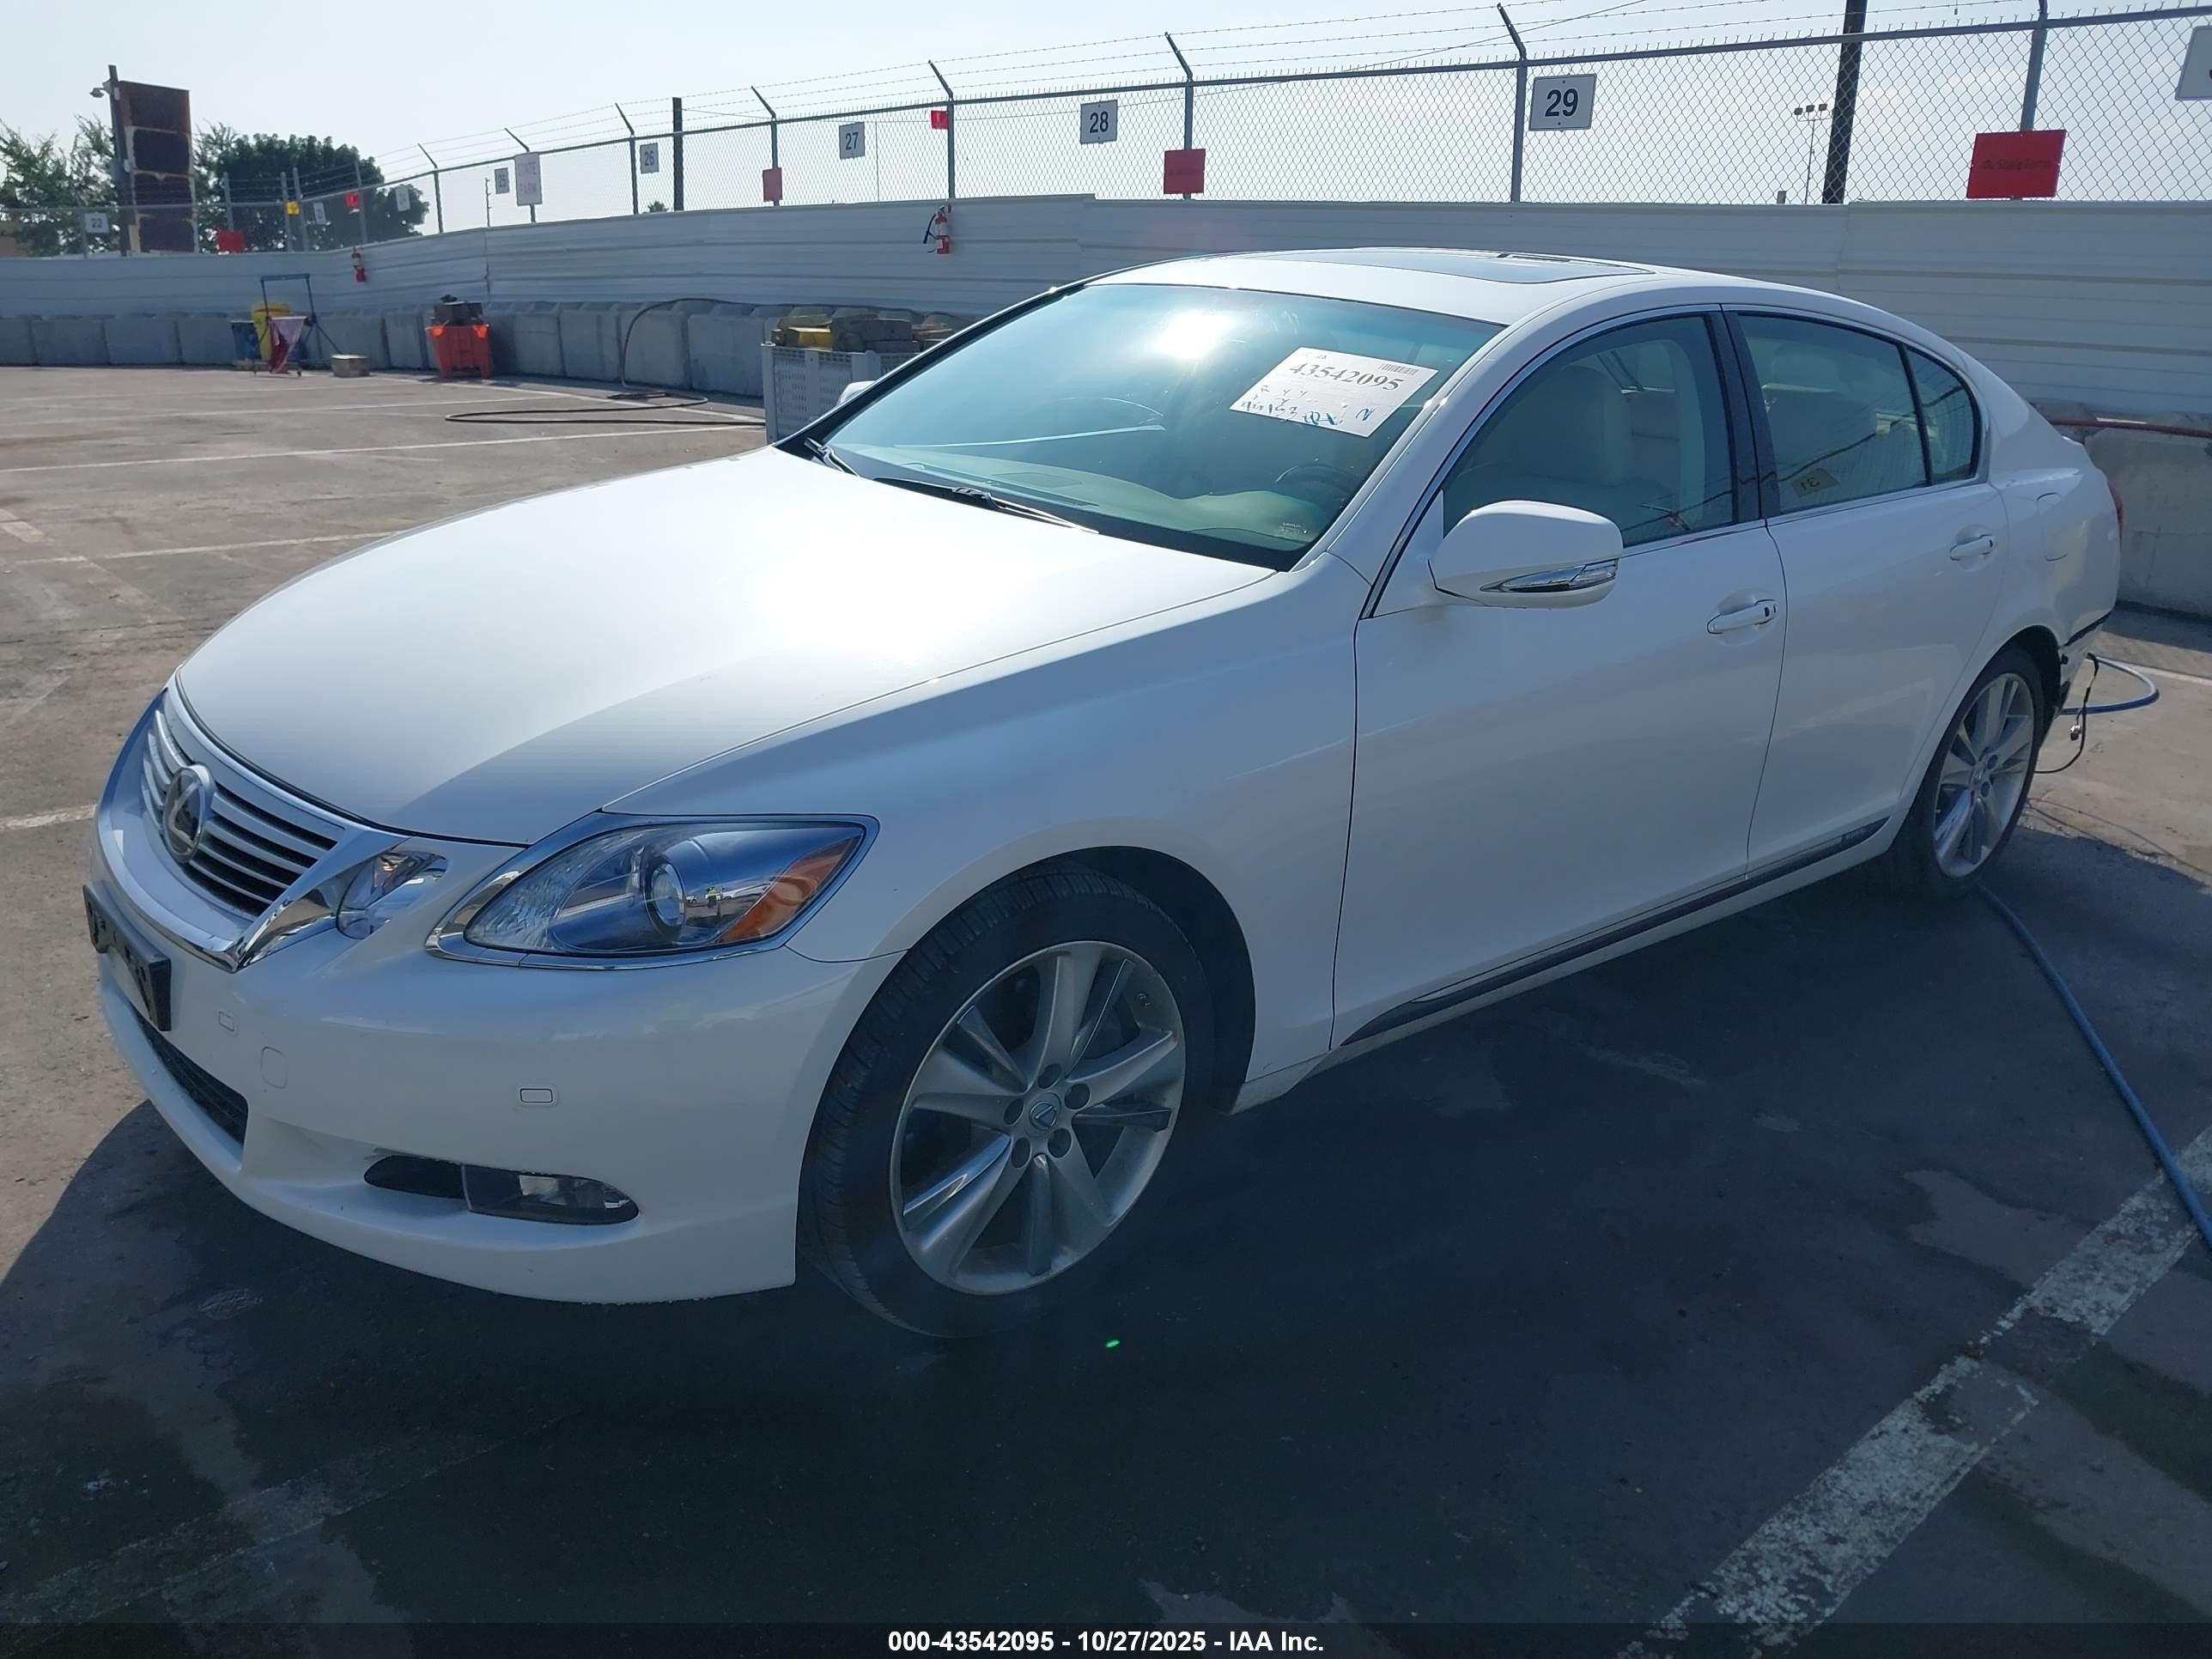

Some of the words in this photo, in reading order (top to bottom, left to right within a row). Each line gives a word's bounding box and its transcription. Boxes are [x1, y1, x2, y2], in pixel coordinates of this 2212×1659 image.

[1545, 88, 1579, 117] 29
[1089, 111, 1109, 133] 28
[845, 131, 859, 150] 27
[644, 150, 655, 167] 26
[91, 218, 103, 228] 22
[1289, 362, 1405, 392] 43542095
